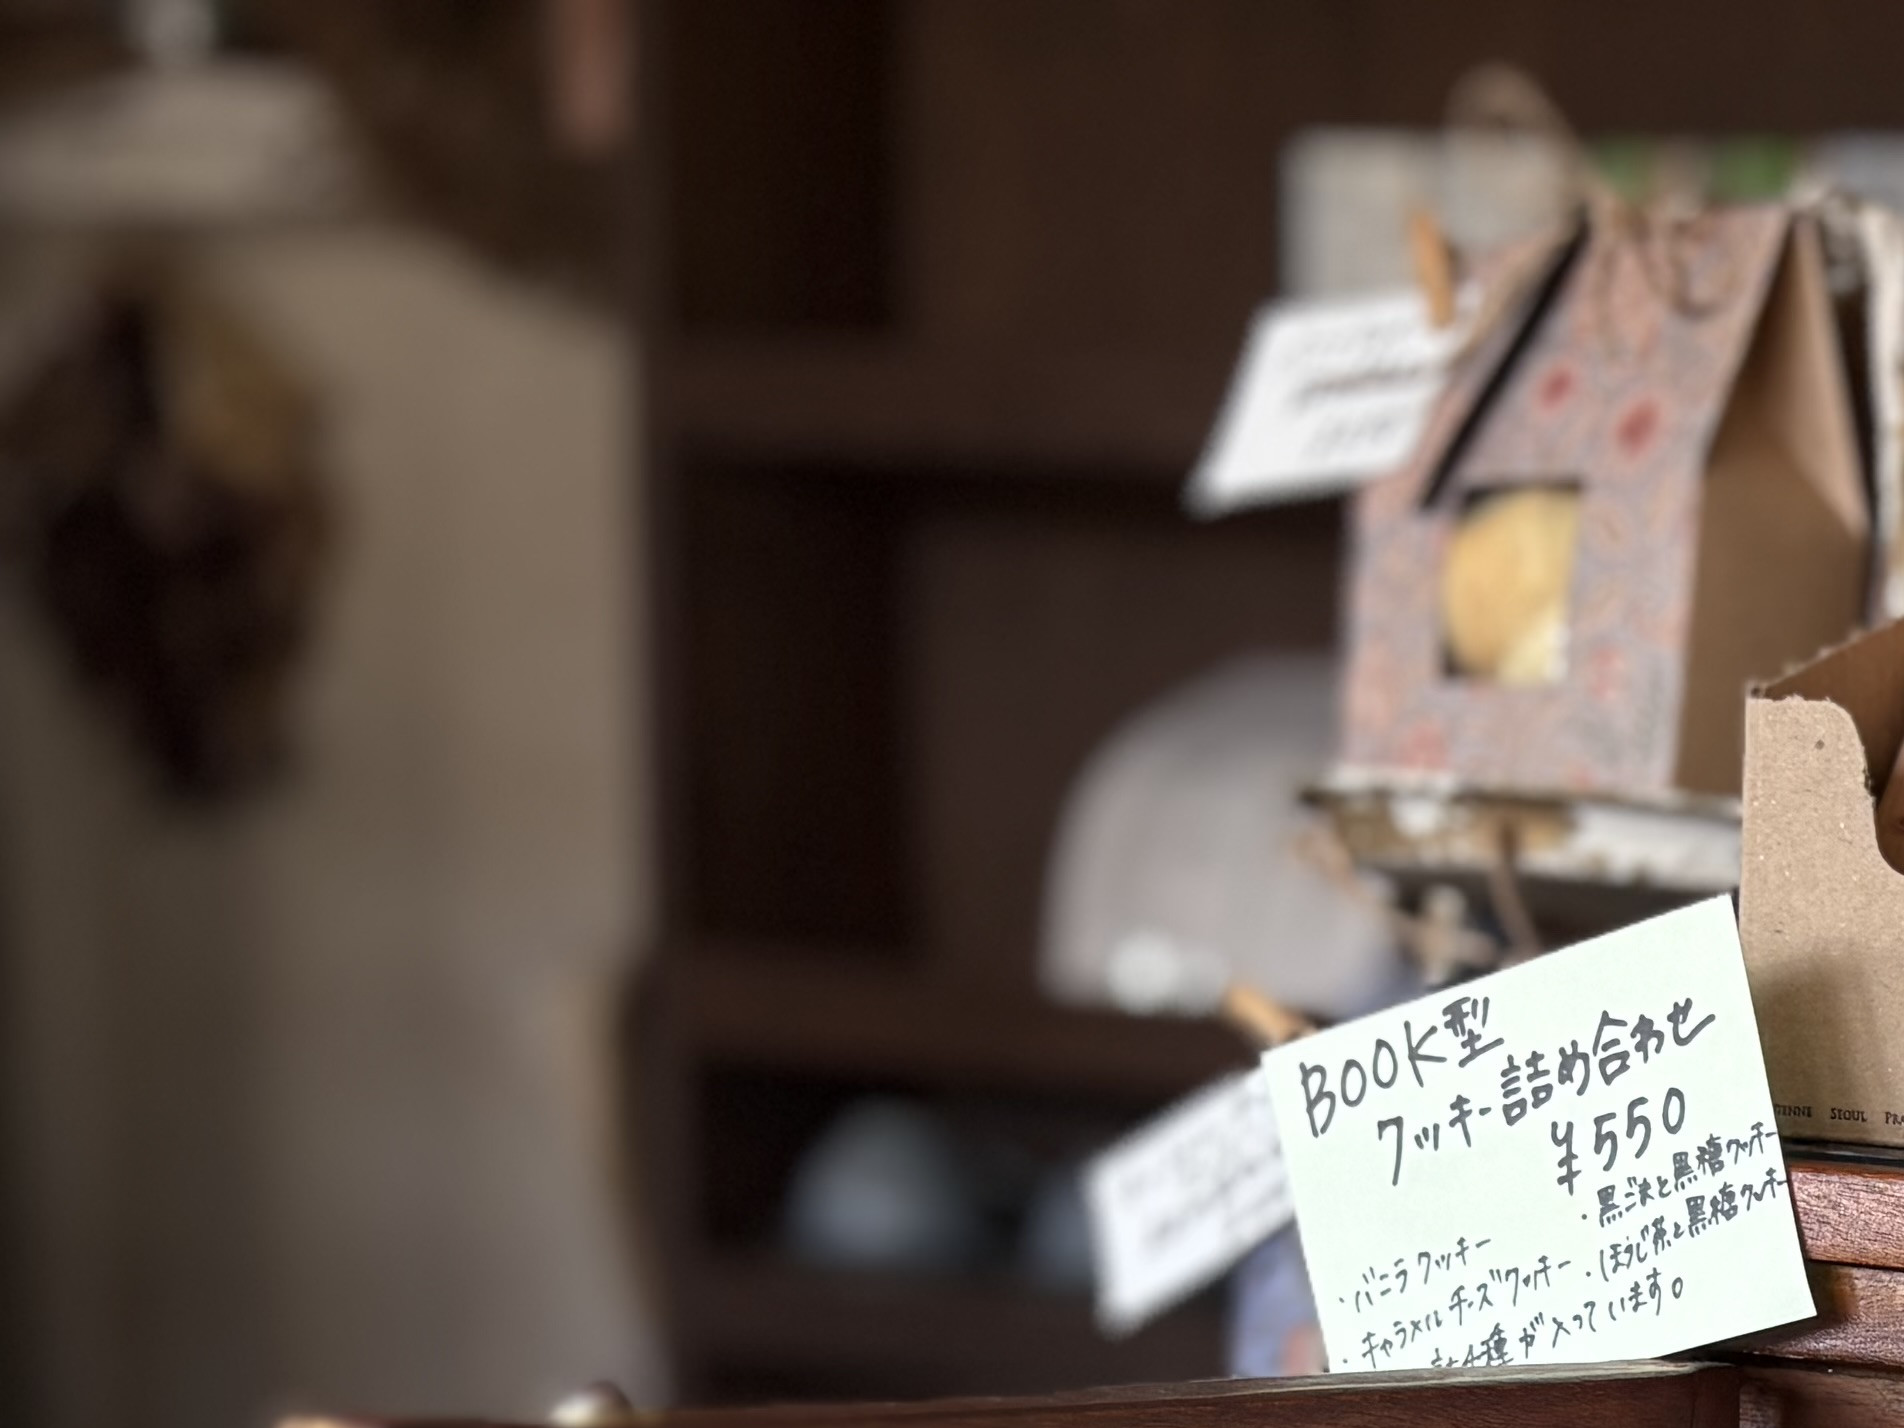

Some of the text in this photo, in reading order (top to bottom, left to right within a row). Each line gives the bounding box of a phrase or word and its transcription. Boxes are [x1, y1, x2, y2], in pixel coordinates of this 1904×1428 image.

[1300, 996, 1505, 1138] BOOK型
[1377, 998, 1717, 1187] クッキー詰め合わせ
[1549, 1088, 1686, 1195] ¥550
